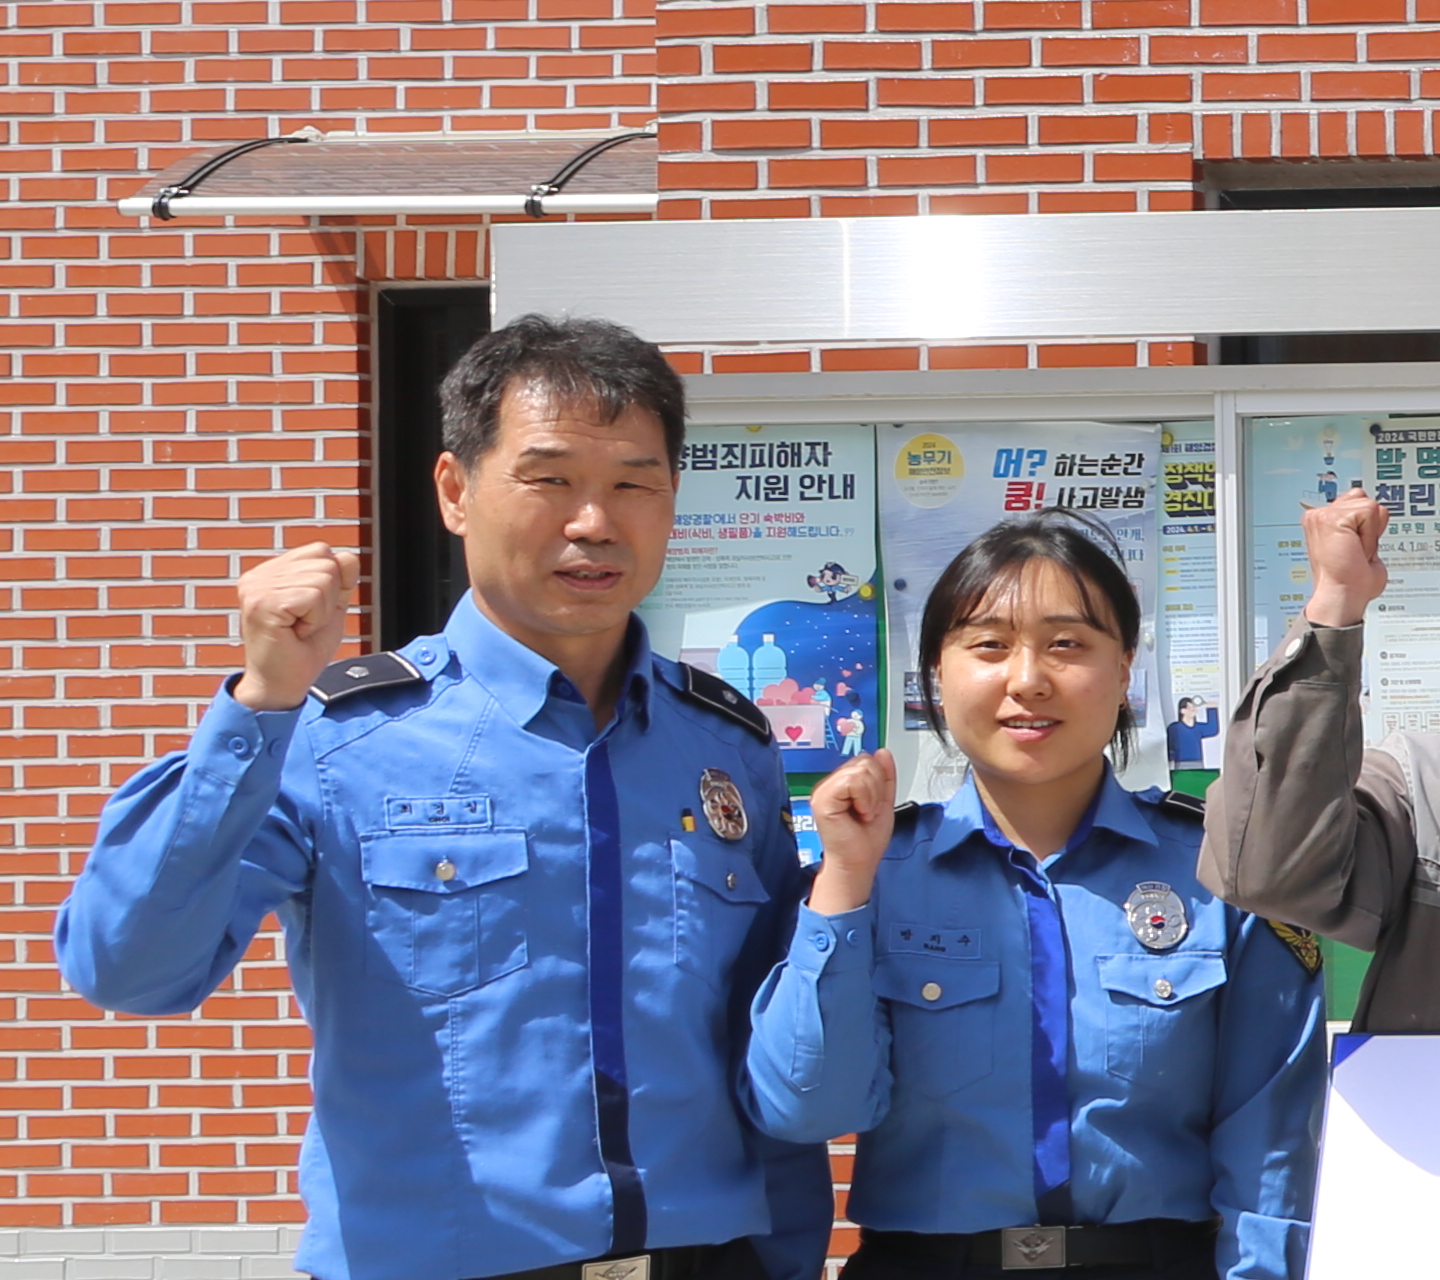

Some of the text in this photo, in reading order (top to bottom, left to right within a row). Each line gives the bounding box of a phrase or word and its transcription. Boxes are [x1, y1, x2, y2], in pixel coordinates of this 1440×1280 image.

[1378, 432, 1404, 442] 2024
[907, 451, 952, 467] 농무기
[993, 448, 1145, 478] 어? 하는순간
[735, 474, 855, 502] 지원 안내
[1004, 481, 1146, 511] 쿵! 사고발생
[1388, 522, 1425, 534] 공무원
